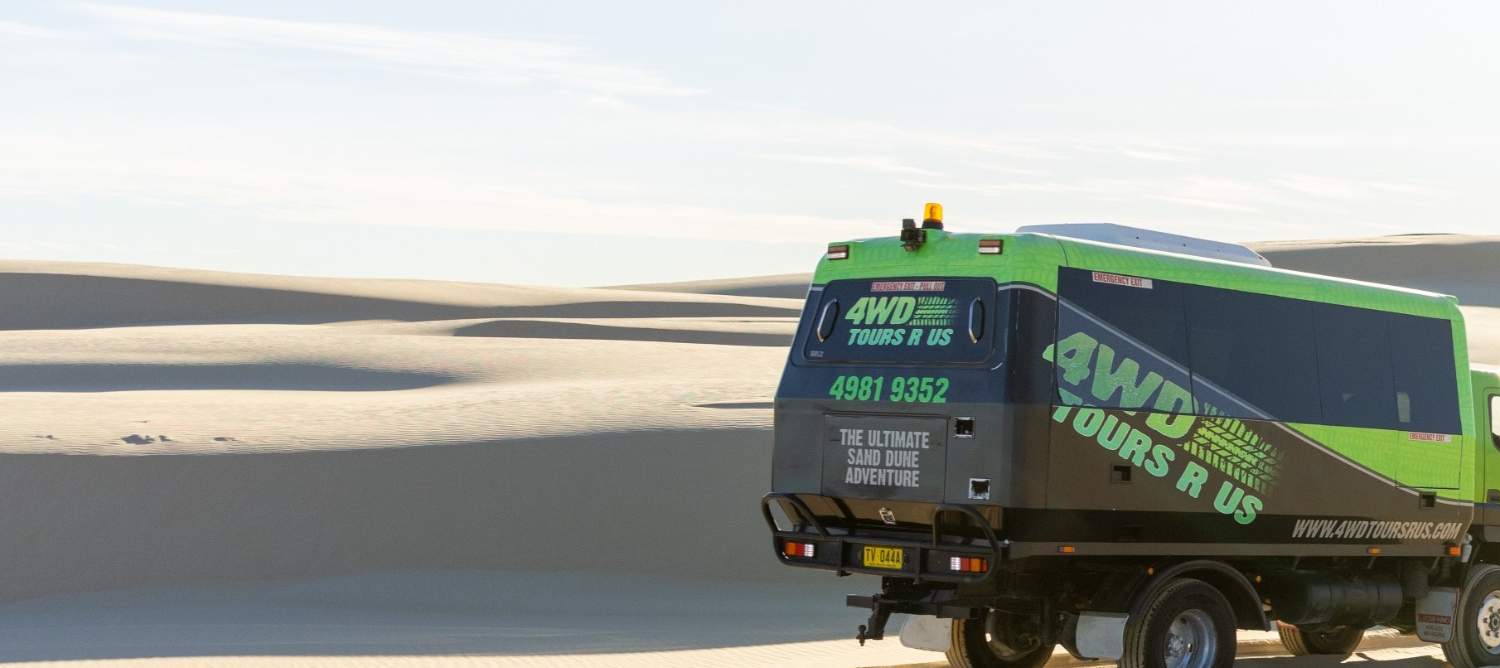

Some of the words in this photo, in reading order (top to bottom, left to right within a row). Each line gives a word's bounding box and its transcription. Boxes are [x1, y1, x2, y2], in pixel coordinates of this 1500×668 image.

[845, 296, 916, 325] 4WD
[848, 328, 905, 345] TOURS
[907, 329, 921, 346] R
[926, 328, 954, 346] US
[829, 375, 884, 401] 4981
[890, 377, 949, 403] 9352
[1042, 332, 1199, 439] 4WD
[840, 428, 863, 446] THE
[868, 430, 930, 449] ULTIMATE
[847, 448, 881, 466] SAND
[886, 450, 919, 468] DUNE
[1052, 387, 1175, 478] TOURS
[1176, 461, 1208, 498] R
[1213, 480, 1263, 524] US
[845, 467, 920, 487] ADVENTURE
[1292, 519, 1463, 540] WWW.4WDTOURSRUS.COM
